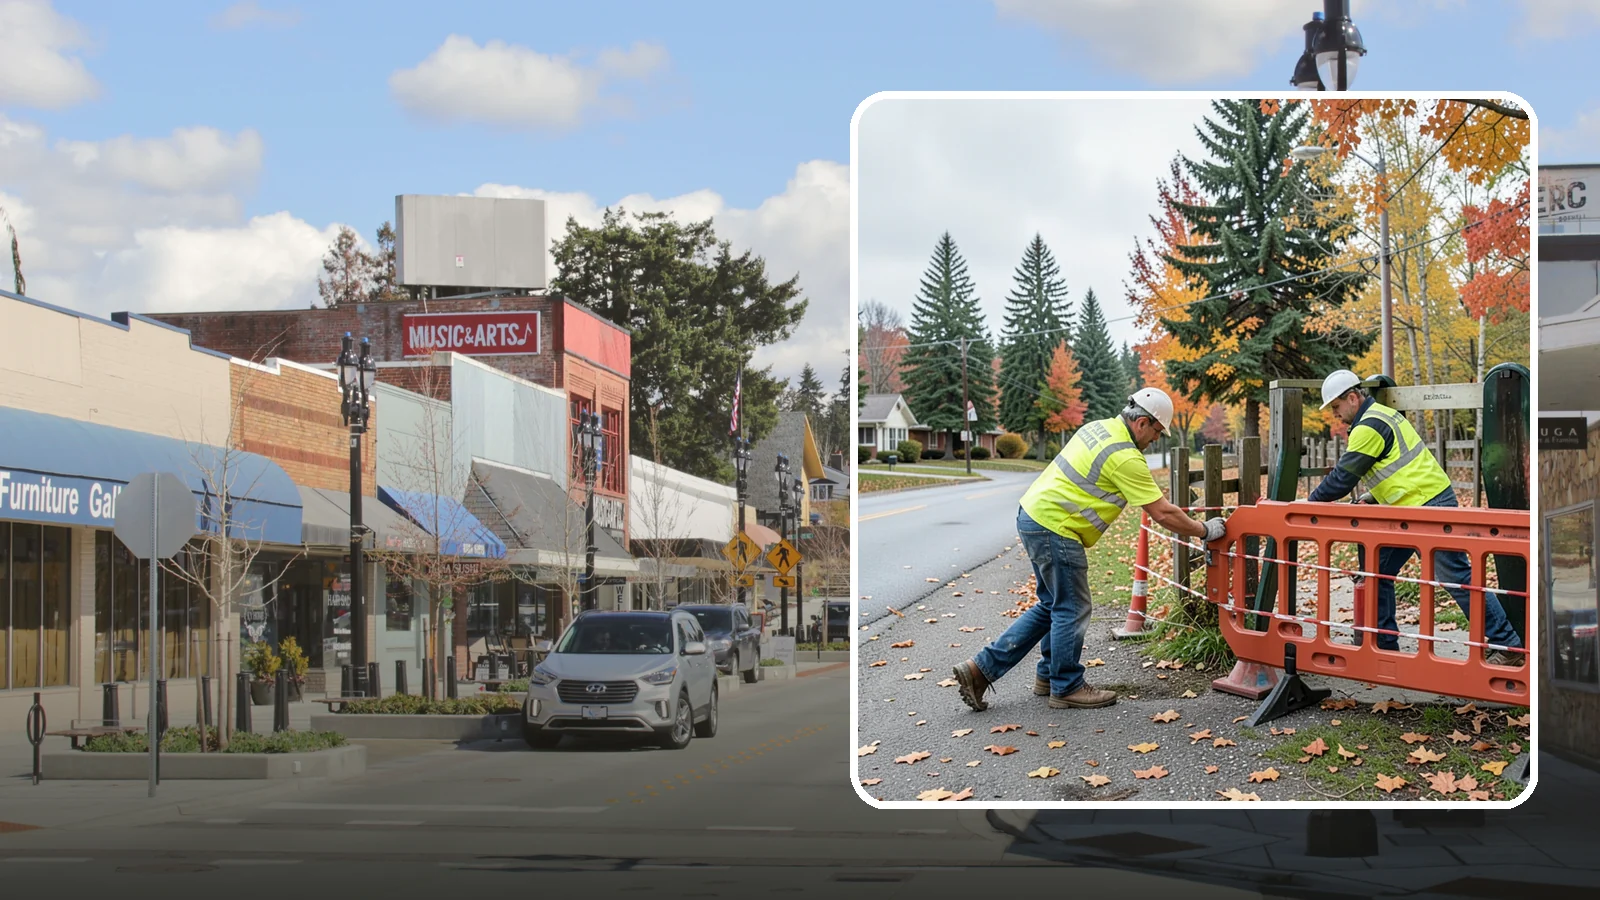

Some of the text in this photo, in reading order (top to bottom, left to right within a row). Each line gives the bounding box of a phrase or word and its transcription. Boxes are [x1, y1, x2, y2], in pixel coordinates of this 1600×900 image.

[409, 322, 519, 349] MUSIC&ARTS
[0, 471, 79, 515] Furniture
[453, 563, 479, 574] SUSHI
